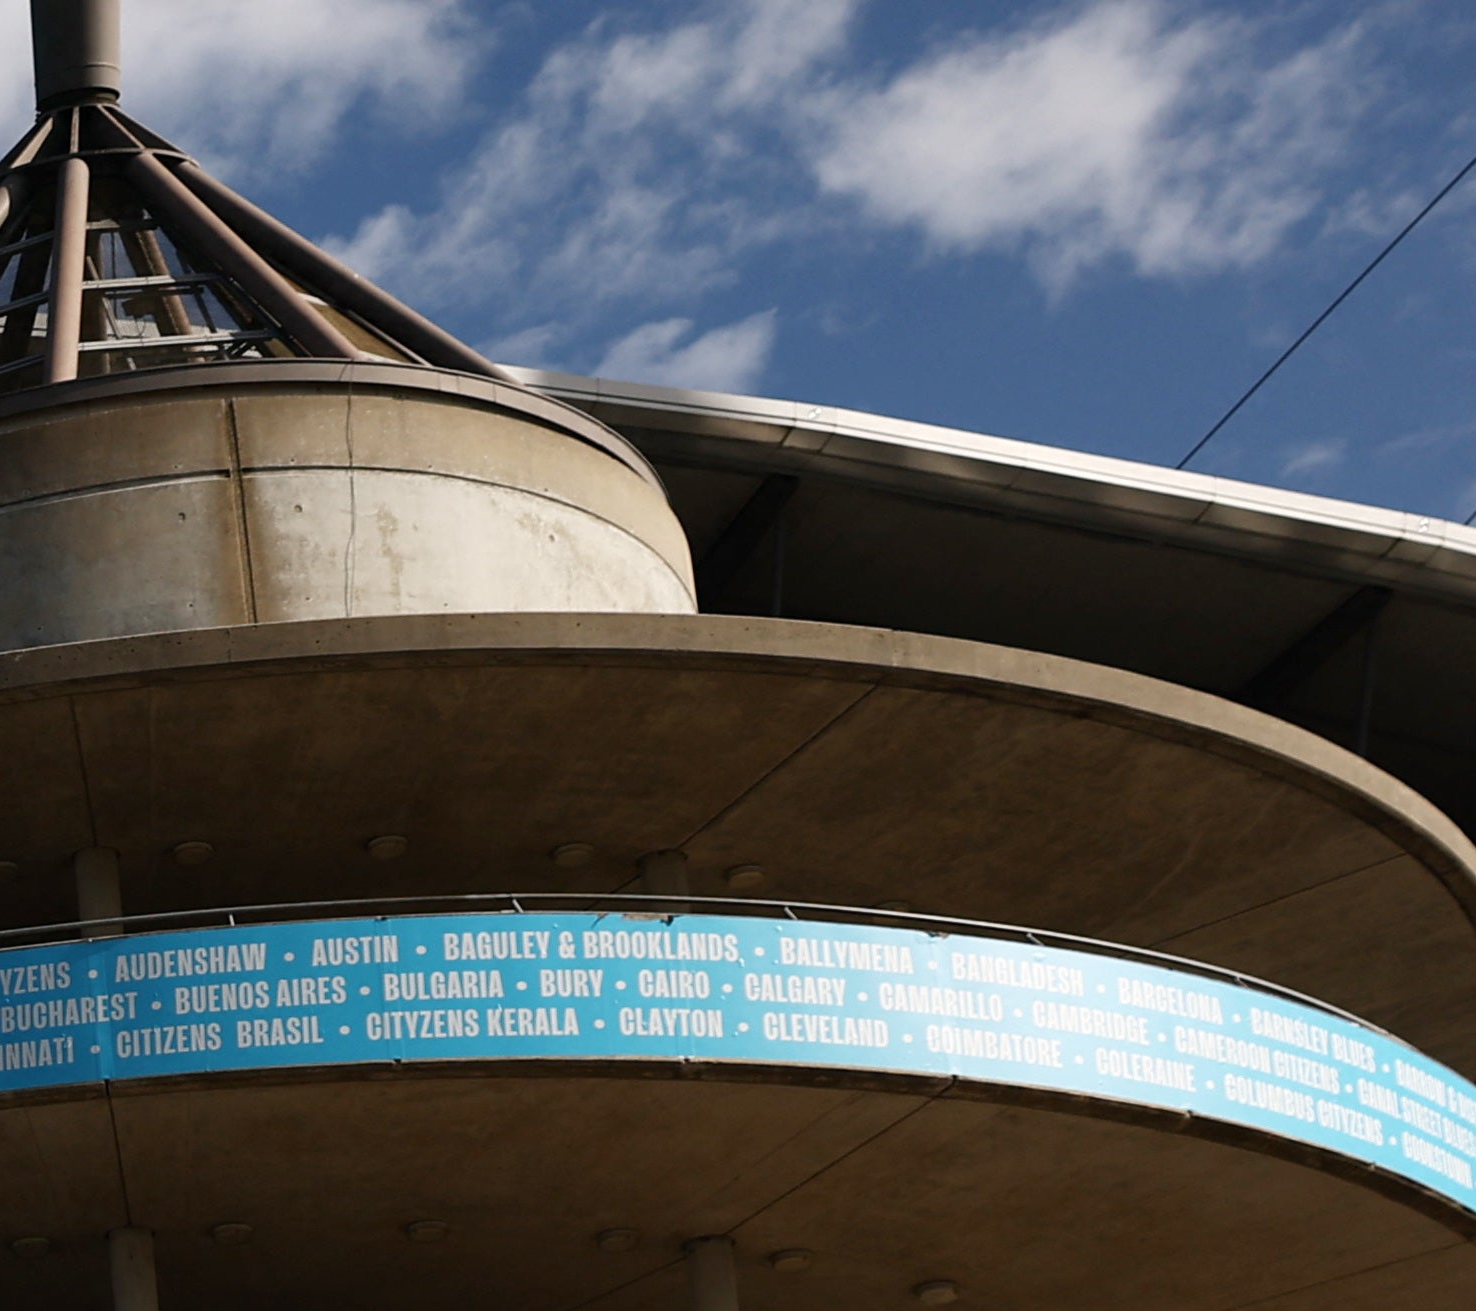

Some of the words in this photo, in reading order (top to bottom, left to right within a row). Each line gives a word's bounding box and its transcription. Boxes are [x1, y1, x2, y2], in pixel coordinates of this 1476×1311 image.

[116, 943, 266, 982] AUDENSHAW
[444, 931, 550, 960] BAGULEY
[583, 931, 739, 962] BROOKLANDS
[781, 937, 915, 975] BALLYMENA
[1, 992, 138, 1033] BUCHAREST
[175, 981, 270, 1014] BUENOS
[384, 970, 504, 1001] BULGARIA
[541, 970, 603, 997] BURY
[237, 1016, 324, 1048] BRASIL
[487, 1007, 579, 1036] KERALA
[620, 1007, 723, 1038] CLAYTON
